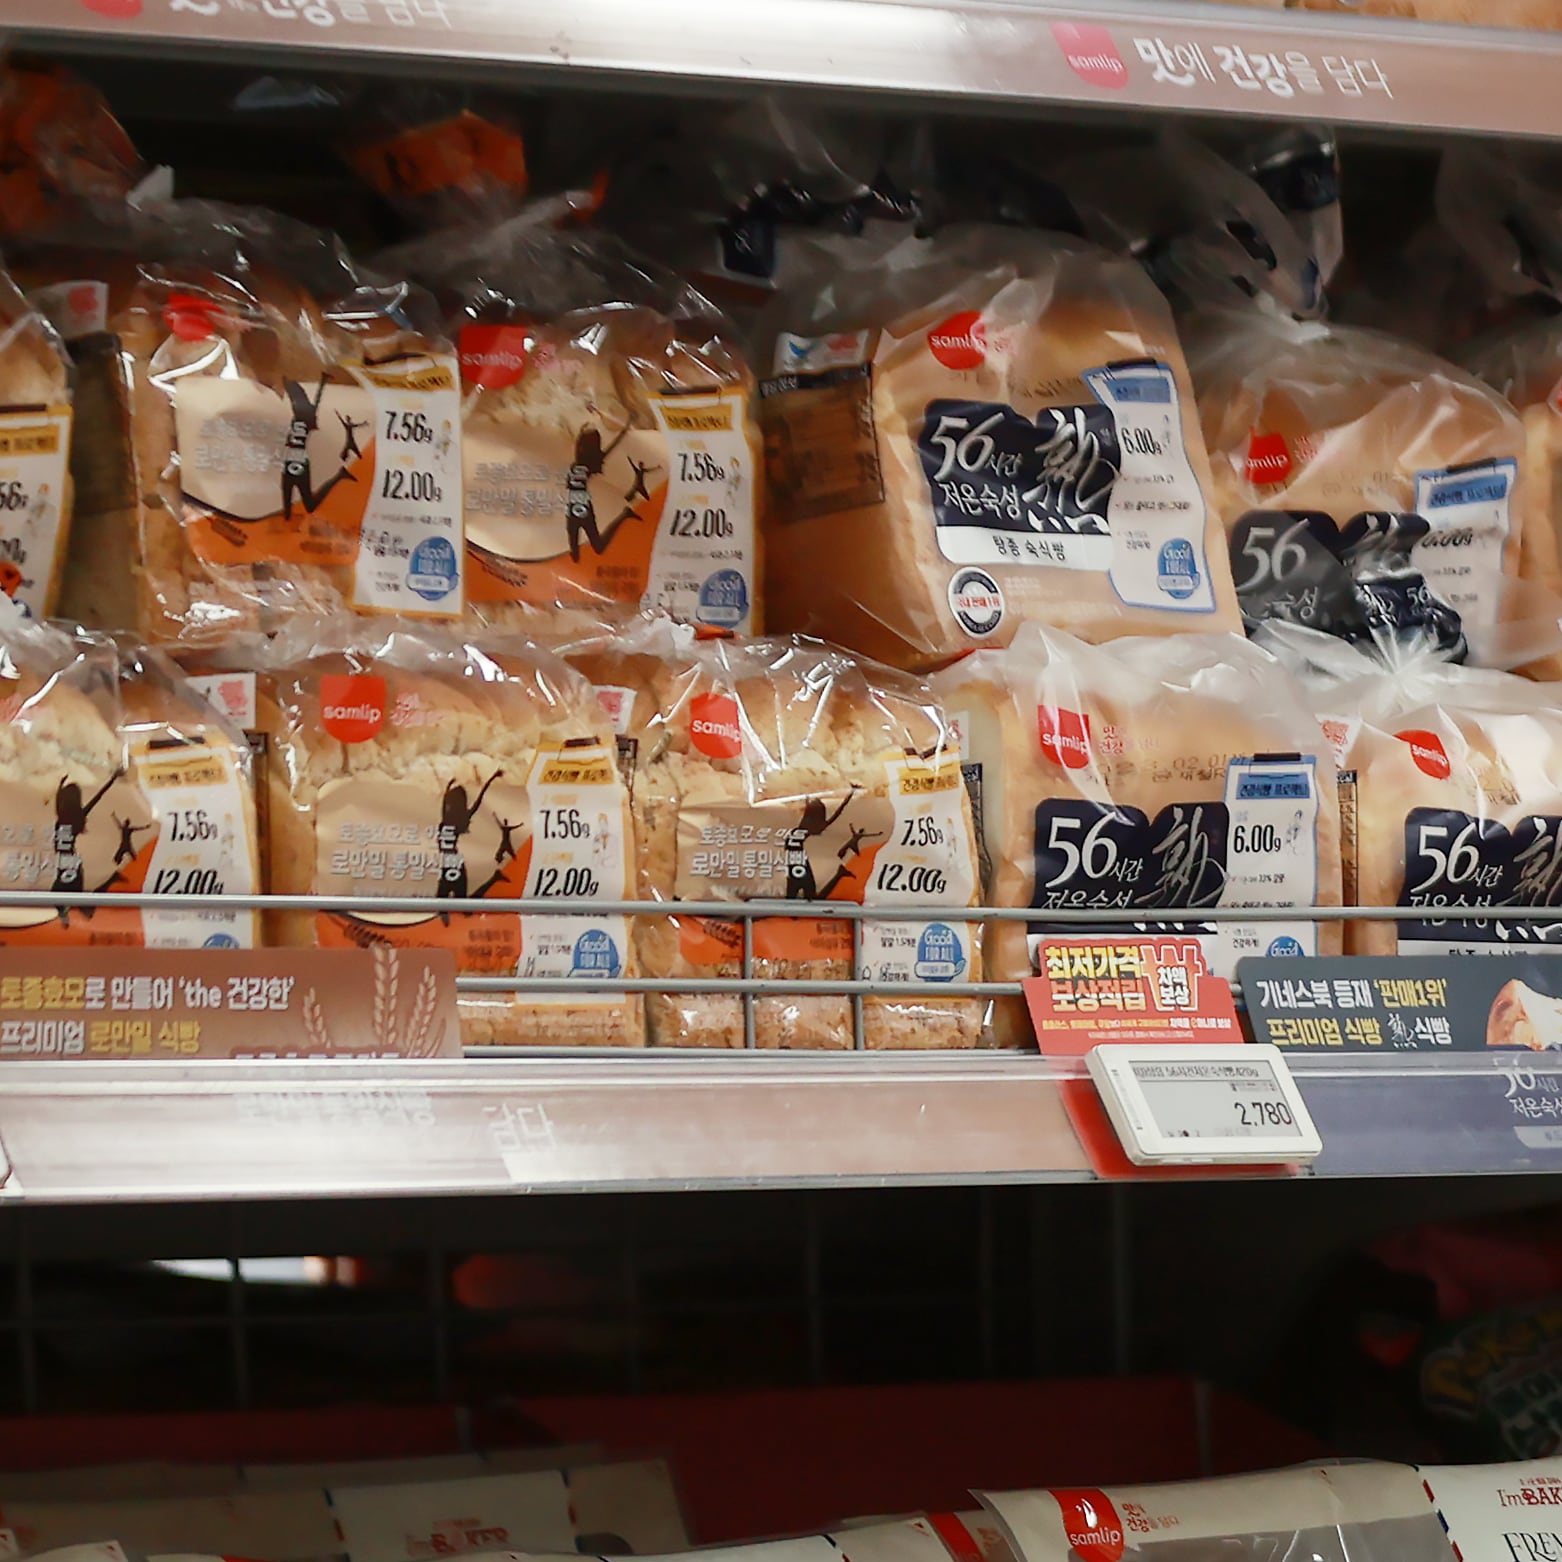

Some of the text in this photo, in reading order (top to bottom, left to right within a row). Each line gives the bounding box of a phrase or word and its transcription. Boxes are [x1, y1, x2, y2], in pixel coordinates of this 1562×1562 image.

[1133, 37, 1393, 100] 맛에 건강을 담다
[929, 411, 1005, 483] 56
[1121, 427, 1162, 457] 6.00g
[381, 468, 442, 502] 12.00g
[935, 482, 1022, 520] 저온숙성
[668, 508, 734, 538] 12.00g
[1236, 517, 1310, 592] 56
[322, 702, 383, 723] samlip
[166, 809, 219, 842] 7.56g
[538, 808, 591, 840] 7.56g
[899, 816, 944, 847] 7.56g
[1233, 824, 1282, 853] 6.00g
[689, 849, 810, 880] 로만밀 통밀식빵
[1045, 811, 1144, 888] 56 시간
[1410, 821, 1504, 894] 56 시간
[533, 867, 599, 897] 12.00g
[876, 862, 948, 895] 12.00g
[1045, 945, 1142, 979] 최저가격
[1158, 966, 1187, 988] 차액
[0, 976, 105, 1011] 토종효모로
[111, 976, 174, 1011] 만들어
[1050, 980, 1147, 1013] 보상적립
[1158, 985, 1191, 1007] 보상
[1255, 979, 1333, 1010] 기네스북
[1333, 979, 1374, 1009] 등재
[0, 1020, 86, 1055] 프리미엄
[158, 1020, 202, 1055] 식빵
[1265, 1016, 1384, 1047] 프리미엄 식빵
[1070, 1523, 1121, 1549] samlip
